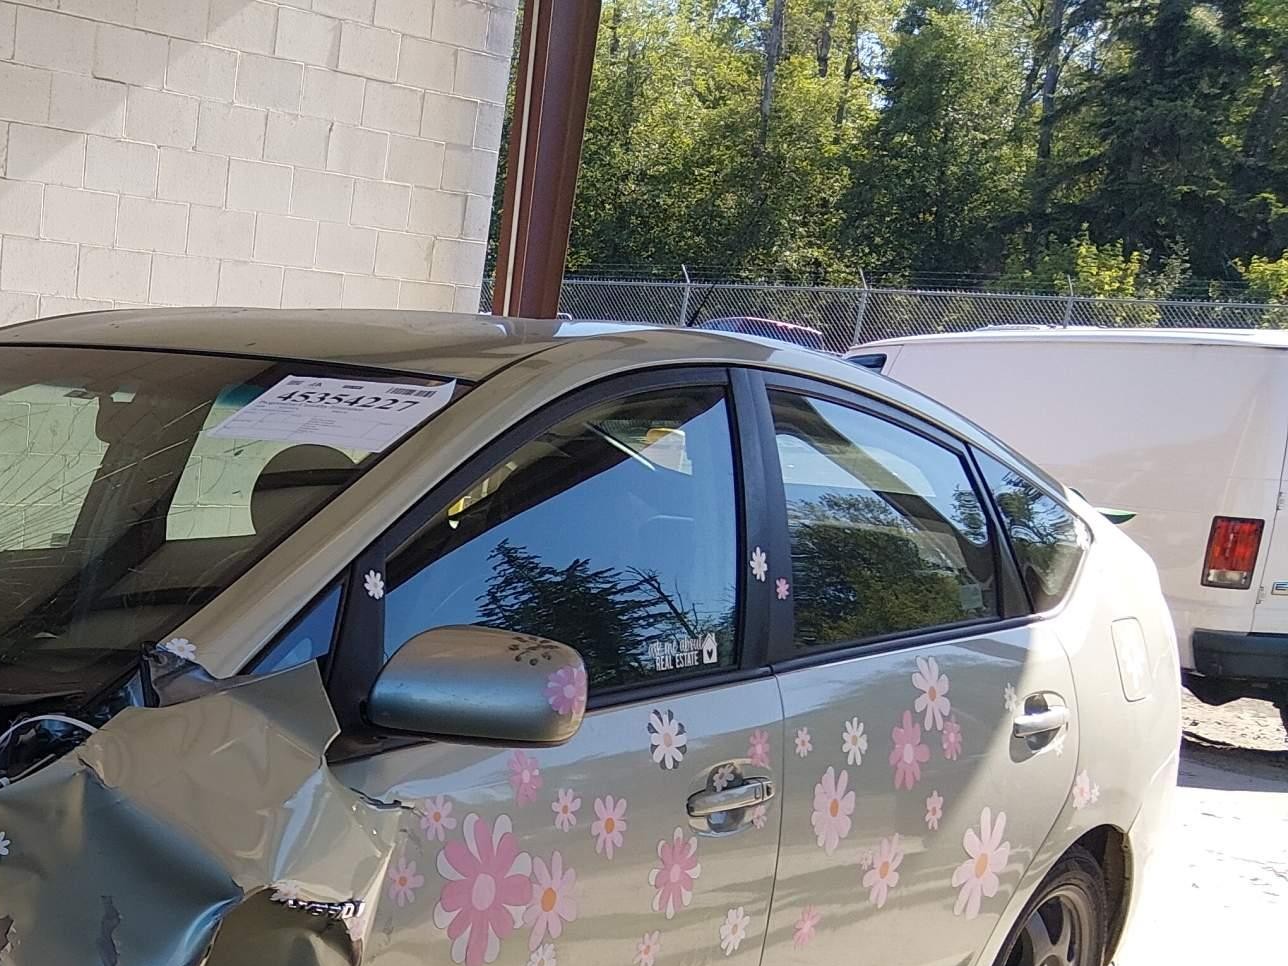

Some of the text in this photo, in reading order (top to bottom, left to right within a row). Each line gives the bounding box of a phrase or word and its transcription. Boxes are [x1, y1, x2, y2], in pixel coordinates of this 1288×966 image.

[277, 390, 419, 412] 45354227
[679, 633, 704, 652] about
[656, 651, 699, 671] REAL ESTATE
